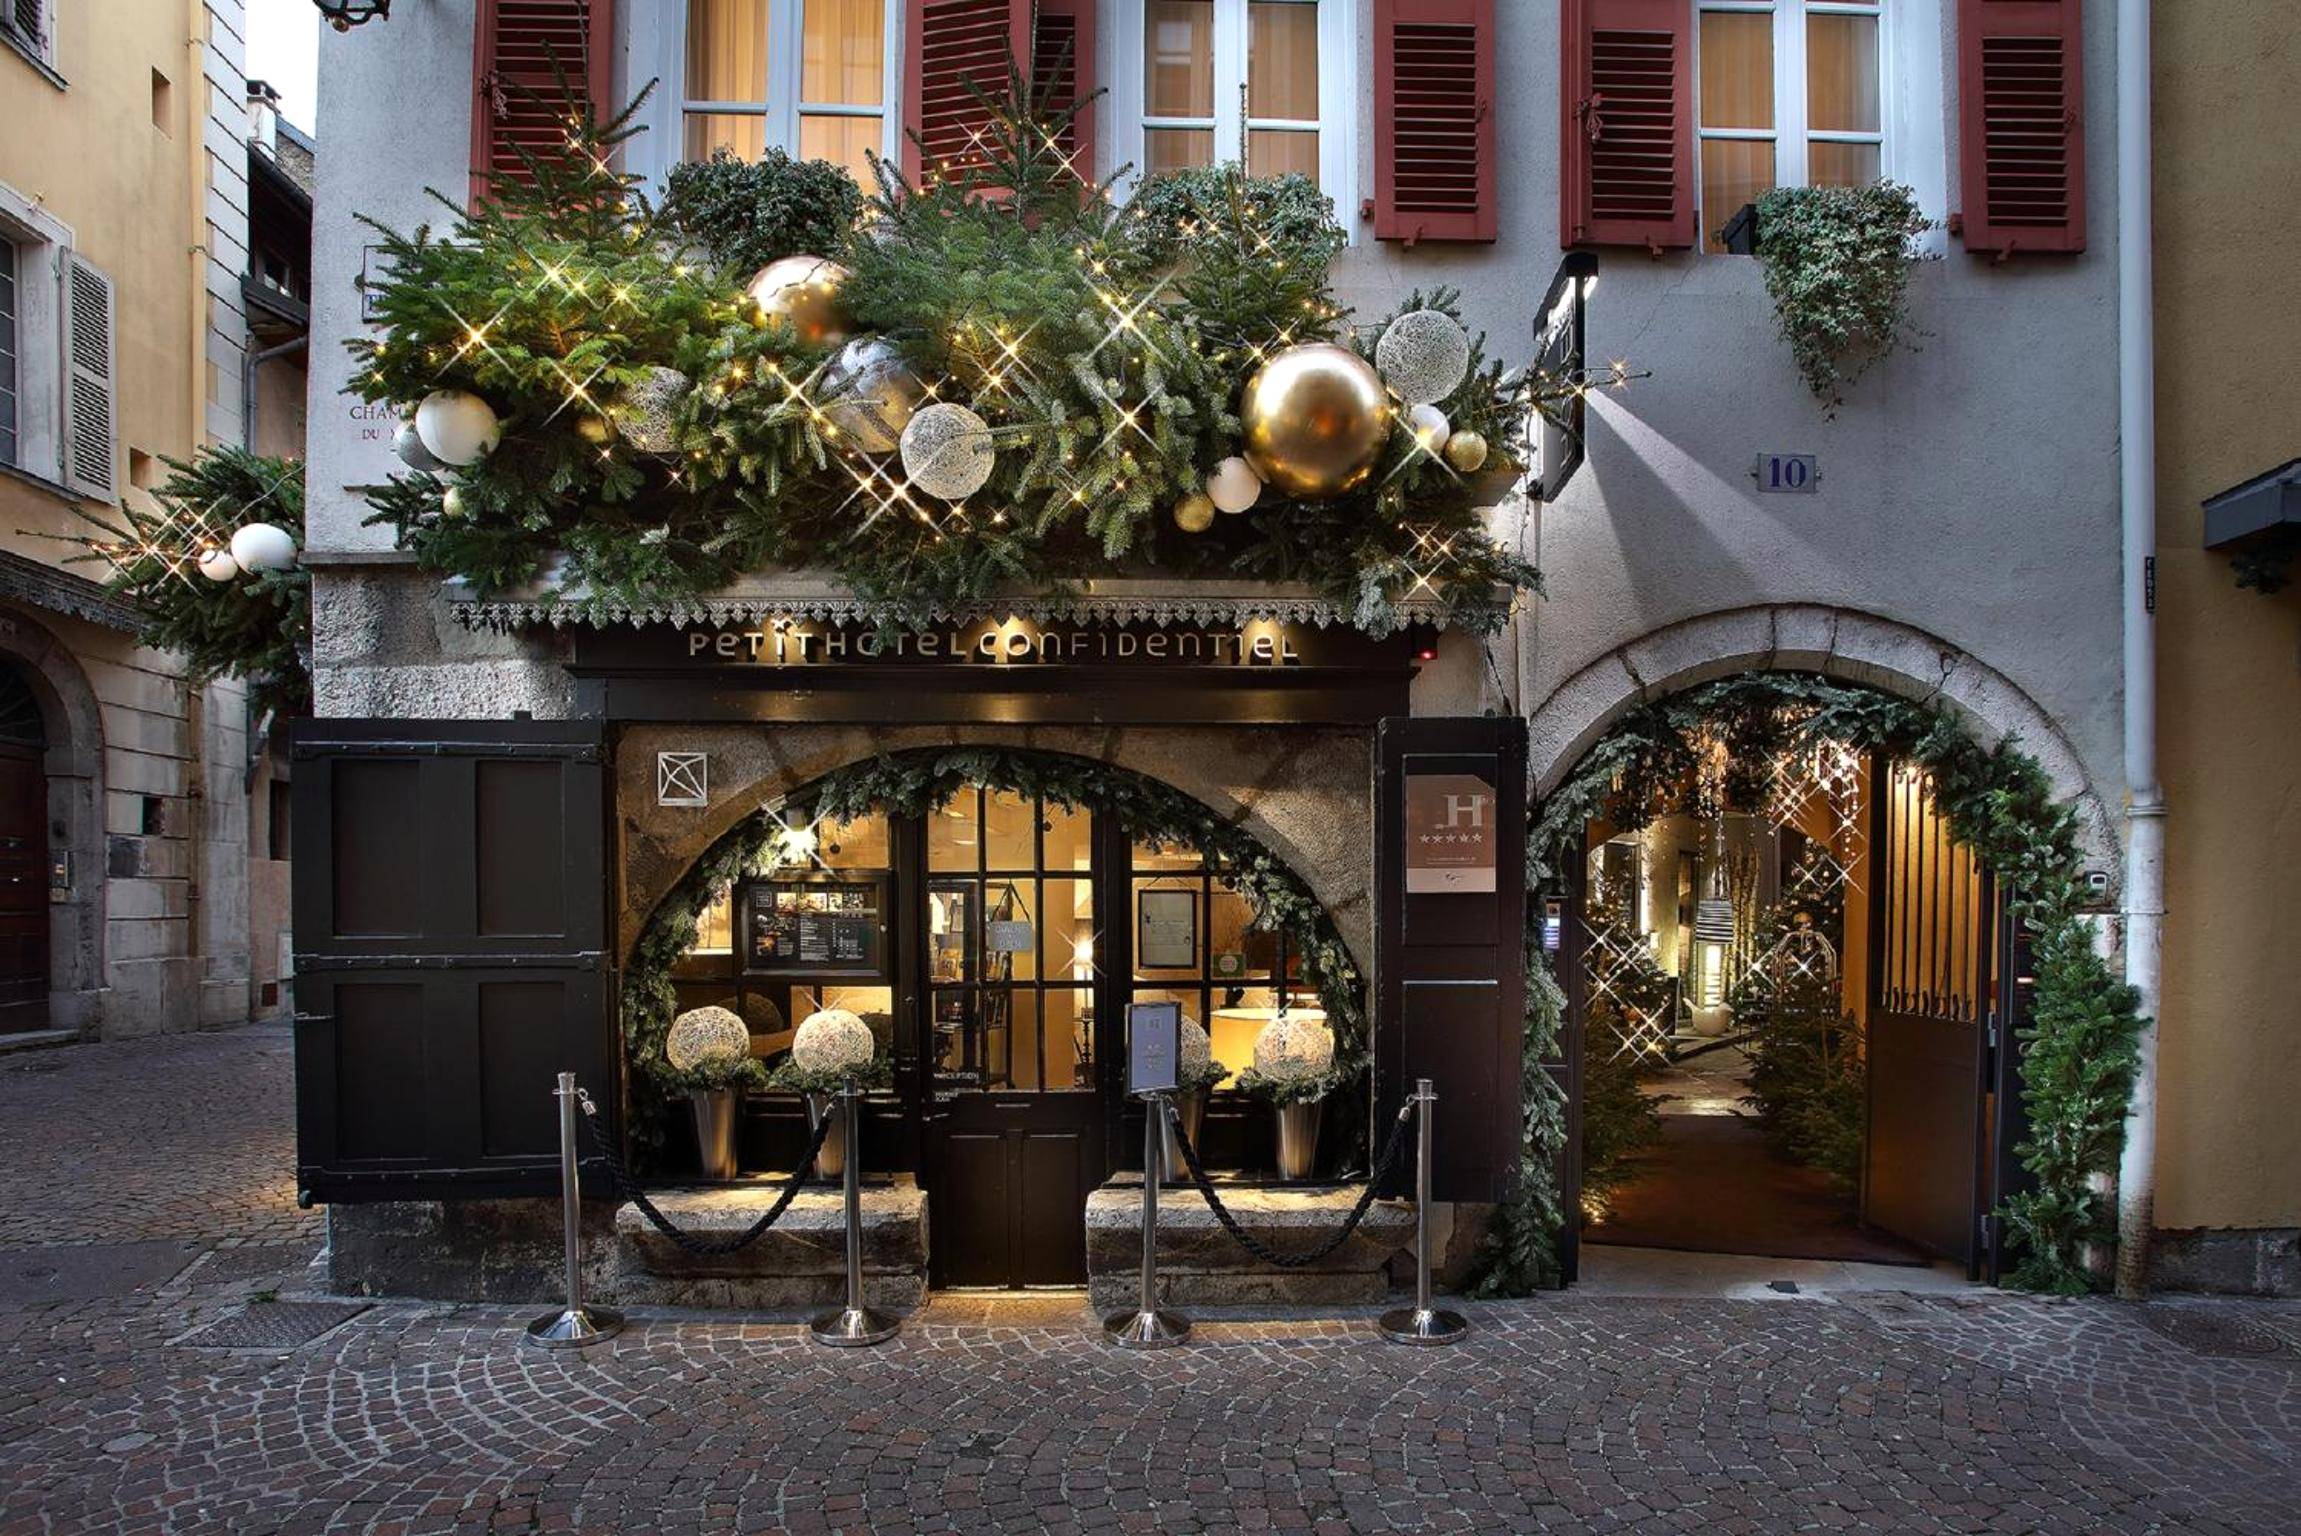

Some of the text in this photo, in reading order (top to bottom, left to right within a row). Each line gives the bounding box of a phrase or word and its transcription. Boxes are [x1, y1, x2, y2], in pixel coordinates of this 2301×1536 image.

[362, 429, 380, 441] DU
[1768, 457, 1807, 488] 10
[1443, 794, 1485, 827] H
